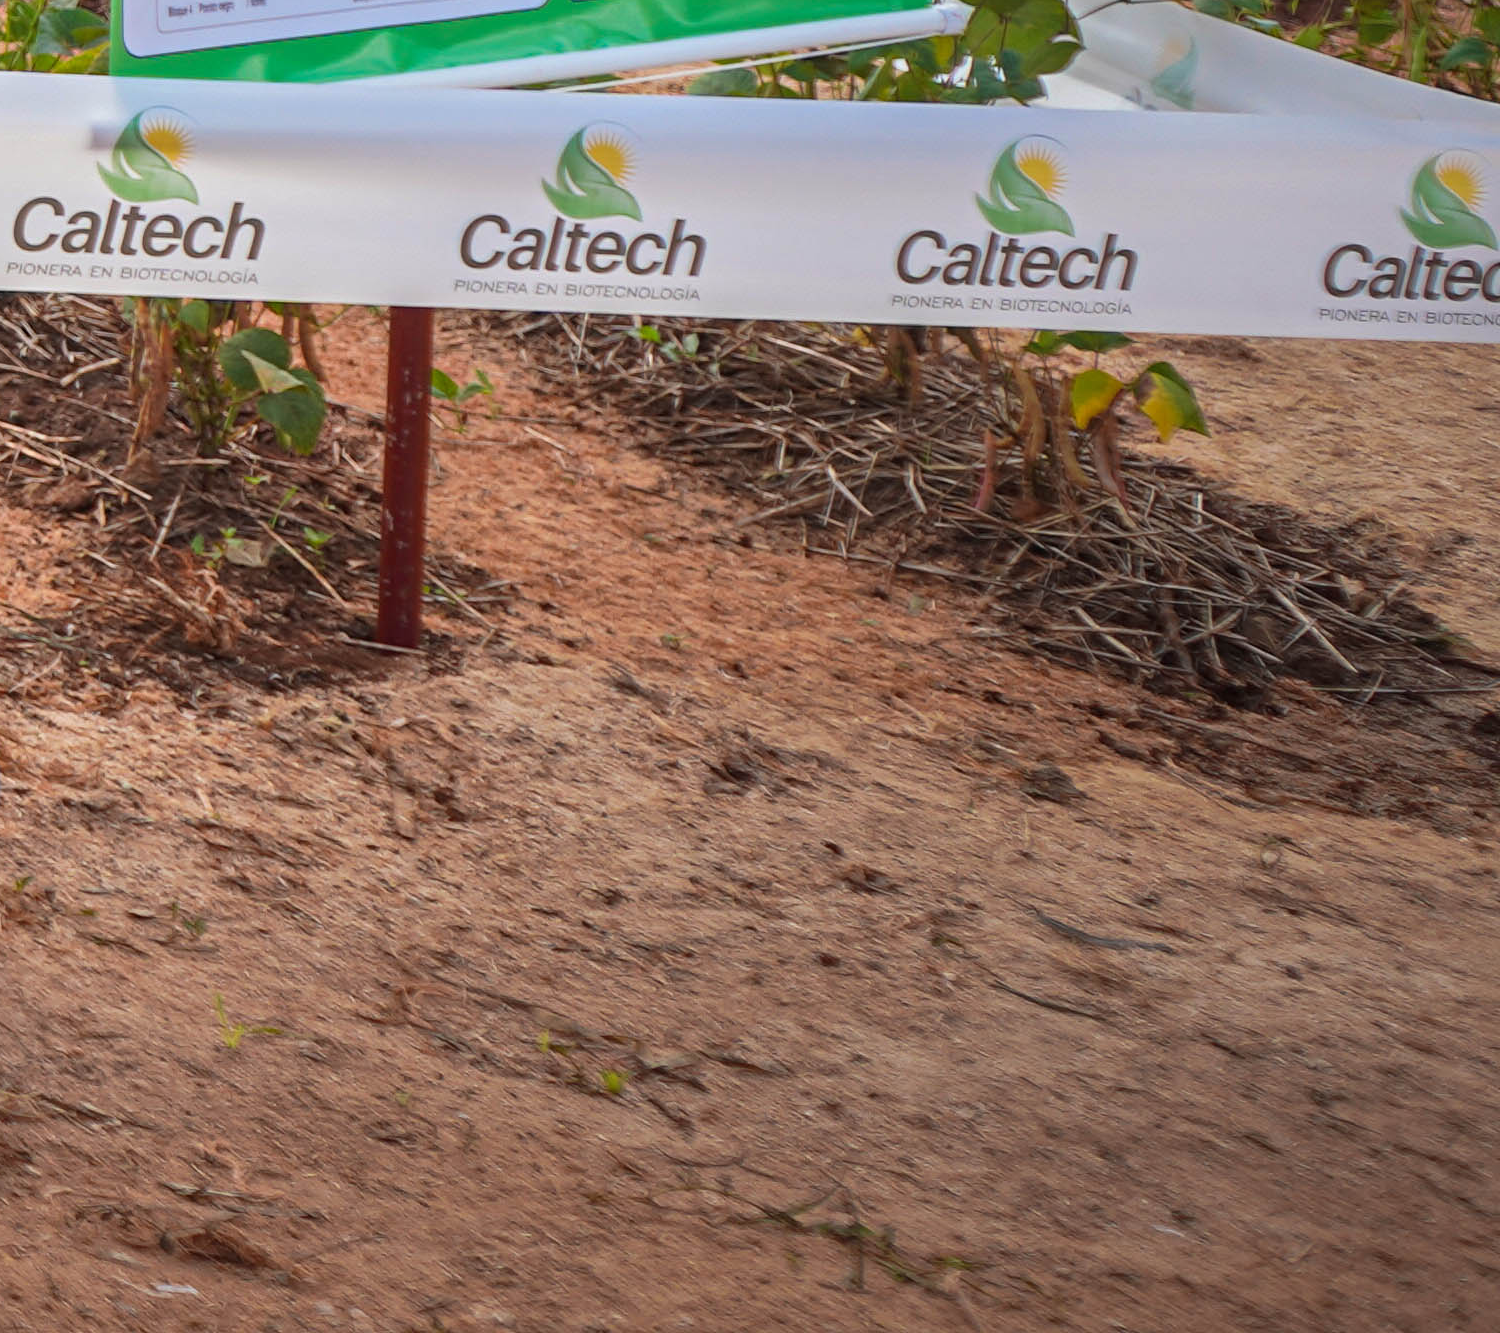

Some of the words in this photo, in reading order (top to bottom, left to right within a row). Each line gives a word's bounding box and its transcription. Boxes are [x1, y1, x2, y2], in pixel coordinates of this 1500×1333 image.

[12, 196, 266, 262] Caltech
[458, 214, 706, 278] Caltech
[6, 261, 83, 277] PIONERA
[90, 265, 114, 279] EN
[120, 267, 259, 286] BIOTECNOLOGÍA
[896, 229, 1139, 292] Caltech
[1323, 243, 1500, 303] Caltec
[453, 278, 531, 295] PIONERA
[536, 282, 560, 297] EN
[564, 284, 701, 303] BIOTECNOLOGÍA
[891, 294, 965, 309] PIONERA
[970, 297, 995, 310] EN
[1000, 298, 1134, 316] BIOTECNOLOGÍA
[1319, 308, 1391, 323] PIONERA
[1396, 310, 1419, 324] EN
